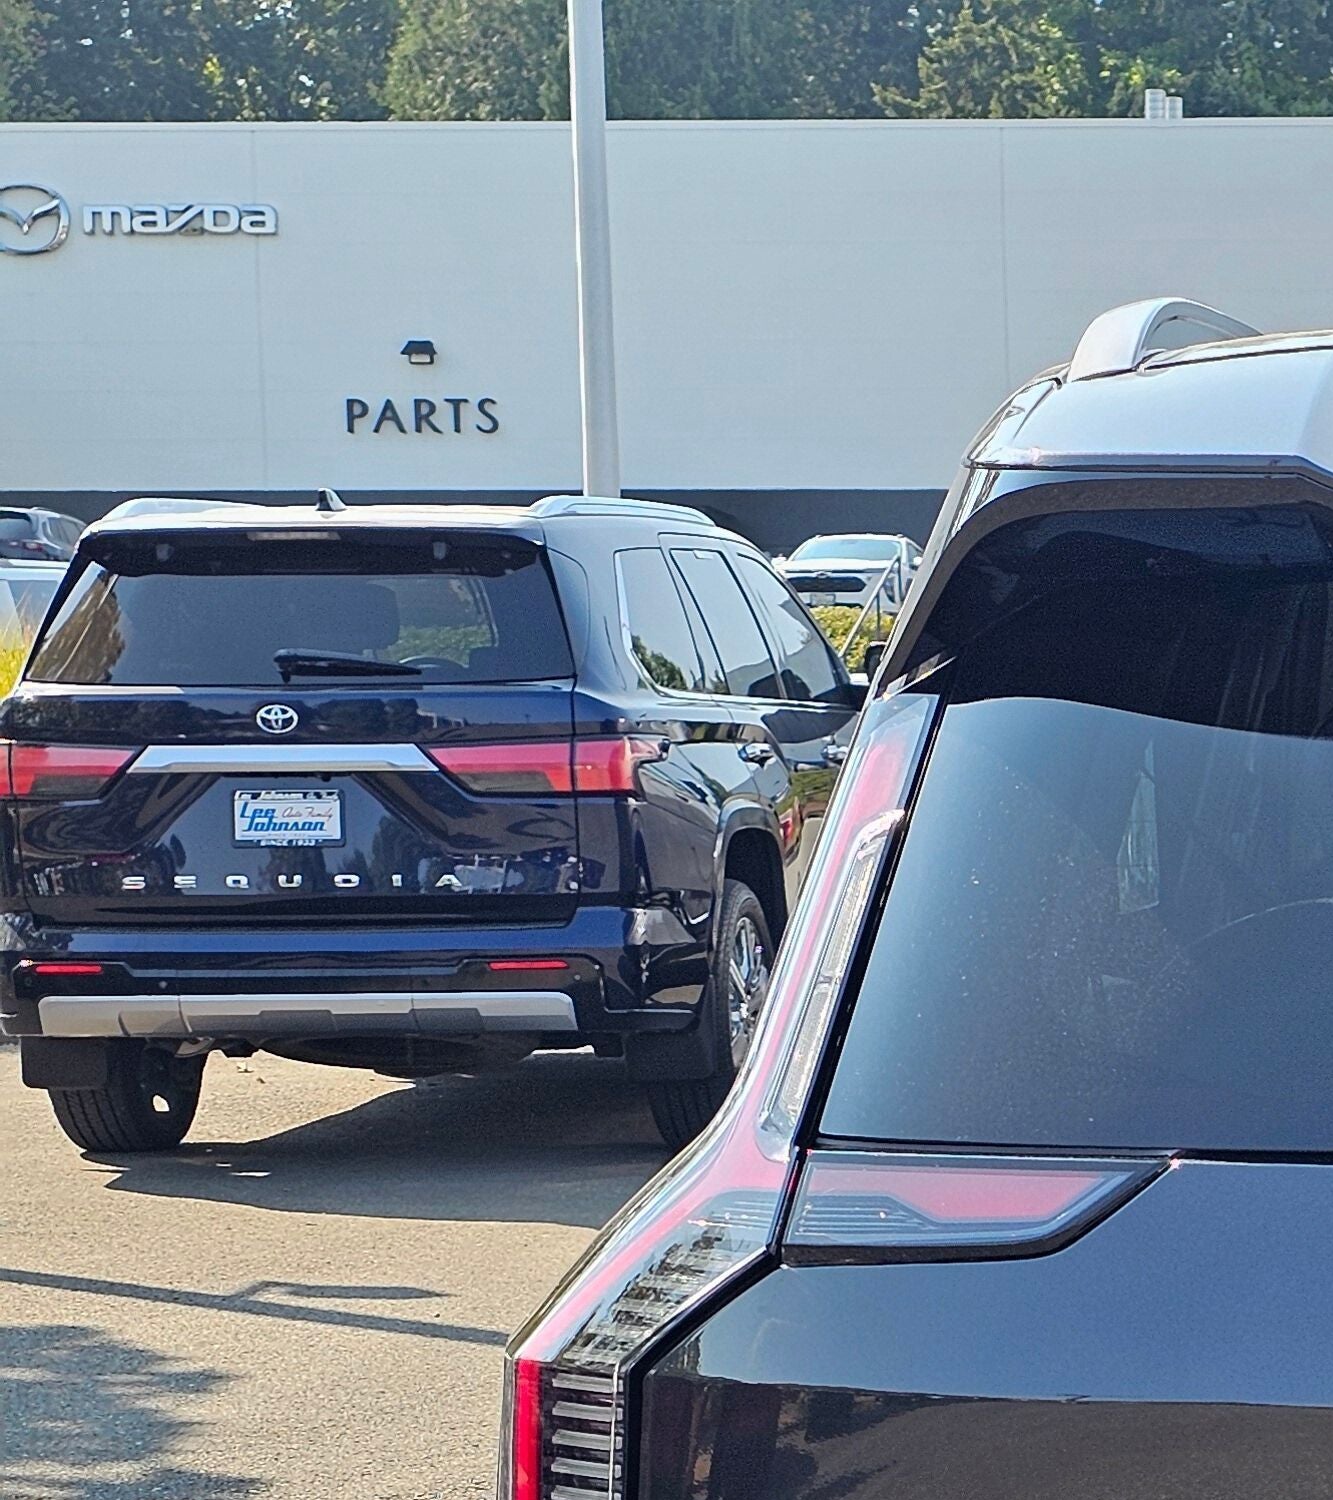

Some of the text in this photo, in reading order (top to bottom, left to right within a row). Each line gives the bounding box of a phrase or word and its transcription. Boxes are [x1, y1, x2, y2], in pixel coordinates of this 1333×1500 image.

[82, 203, 279, 236] mazda
[345, 397, 500, 434] PARTS
[240, 802, 278, 819] Lee
[241, 816, 327, 833] Johnson
[121, 873, 463, 891] SEQUOIA
